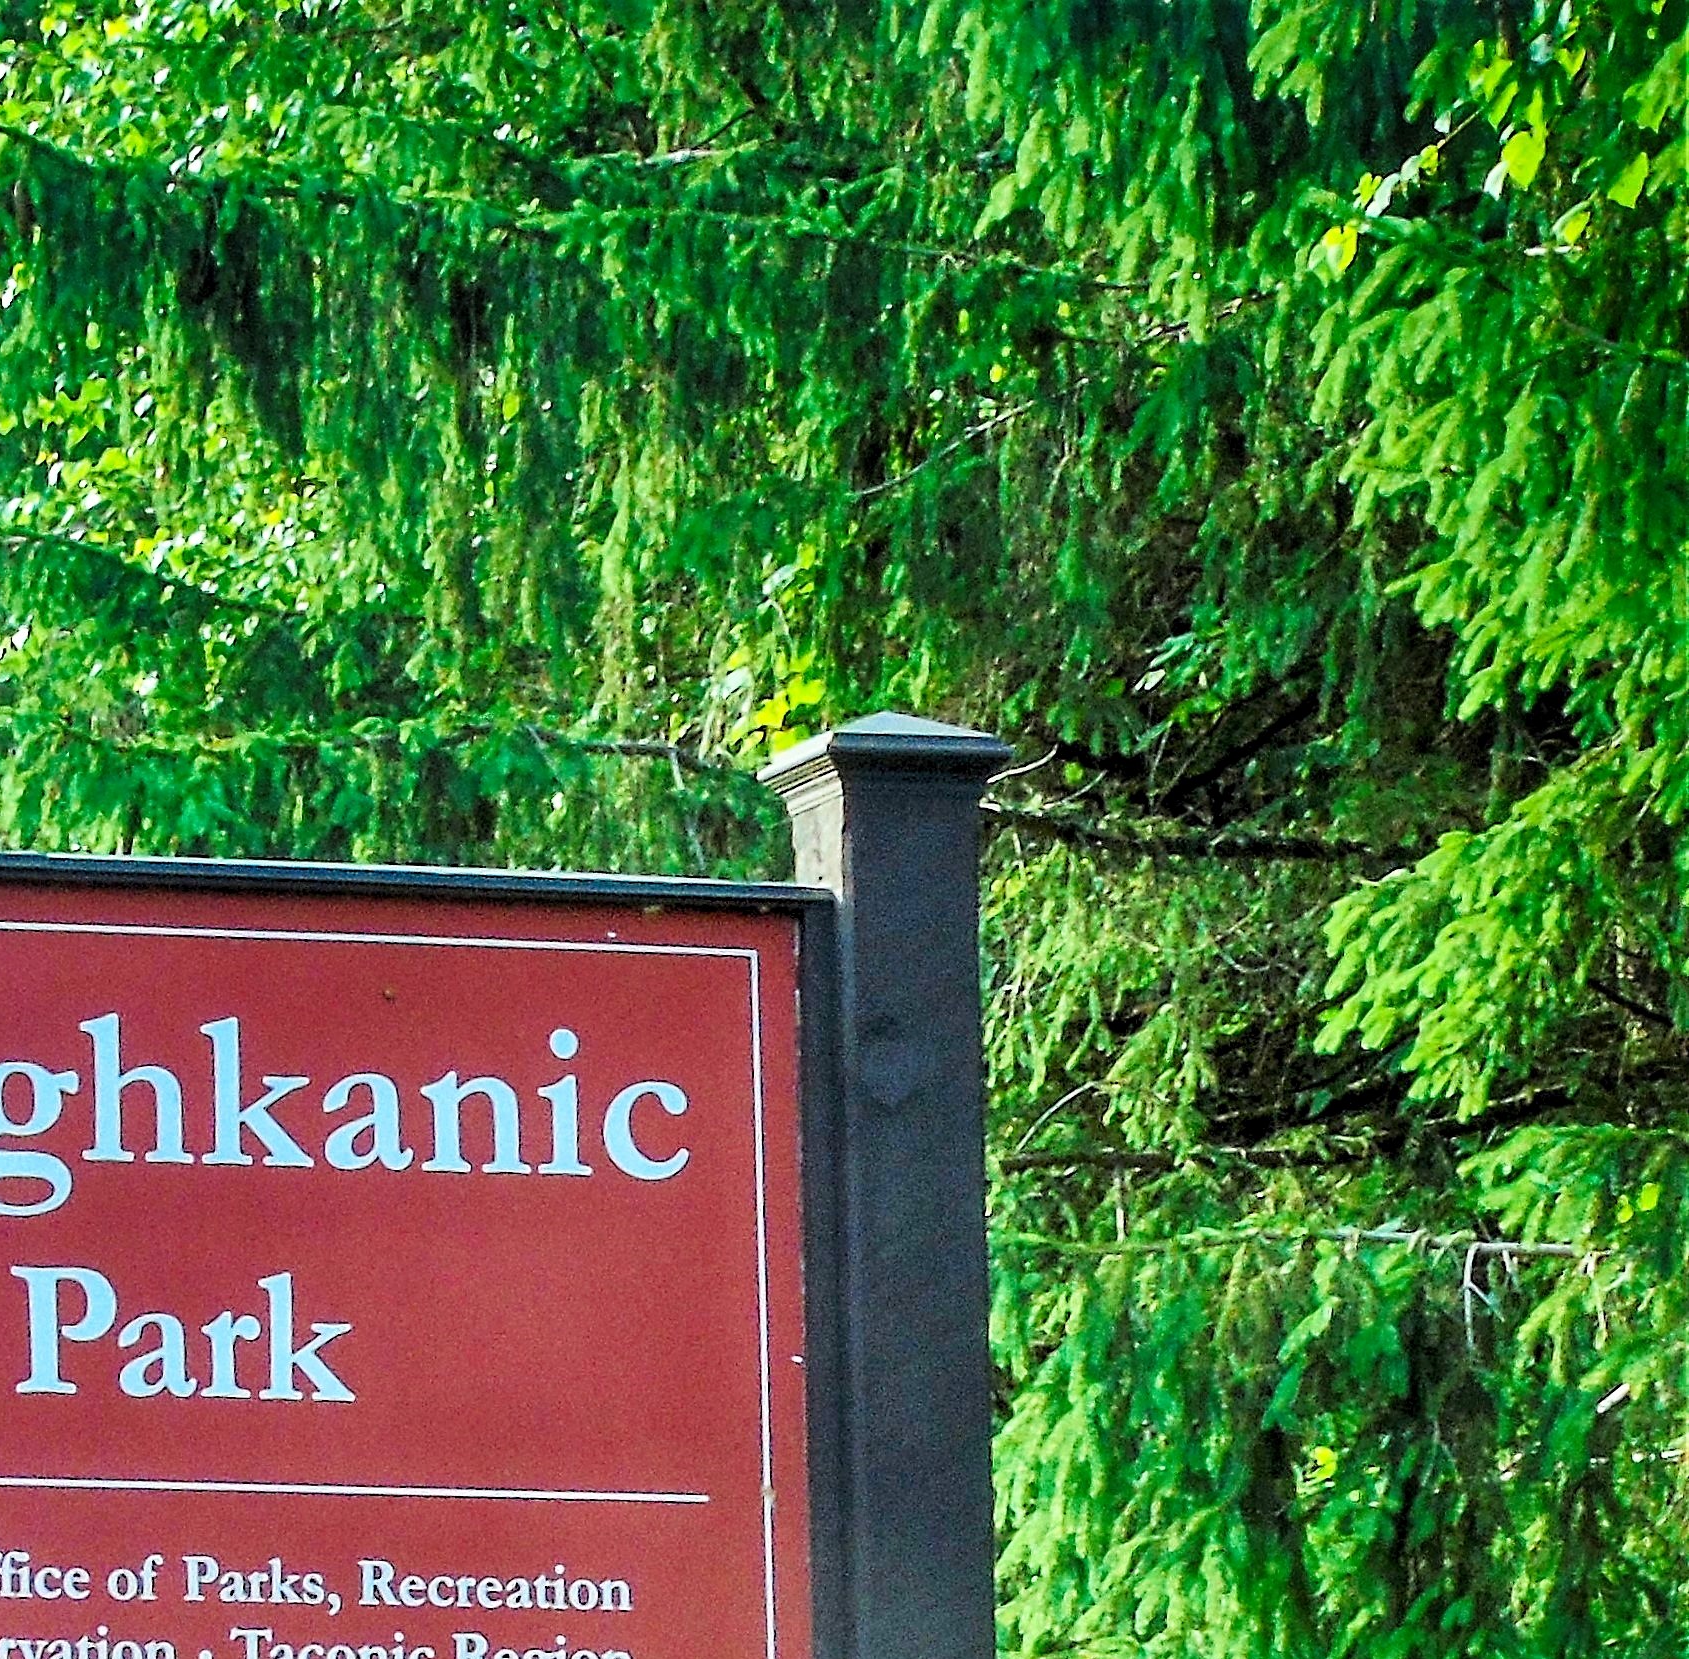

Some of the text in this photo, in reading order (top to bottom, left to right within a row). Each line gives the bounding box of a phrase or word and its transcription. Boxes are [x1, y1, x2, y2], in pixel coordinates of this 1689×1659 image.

[11, 1266, 356, 1403] Park
[107, 1554, 164, 1601] of
[182, 1556, 342, 1615] Parks,
[358, 1560, 634, 1611] Recreation
